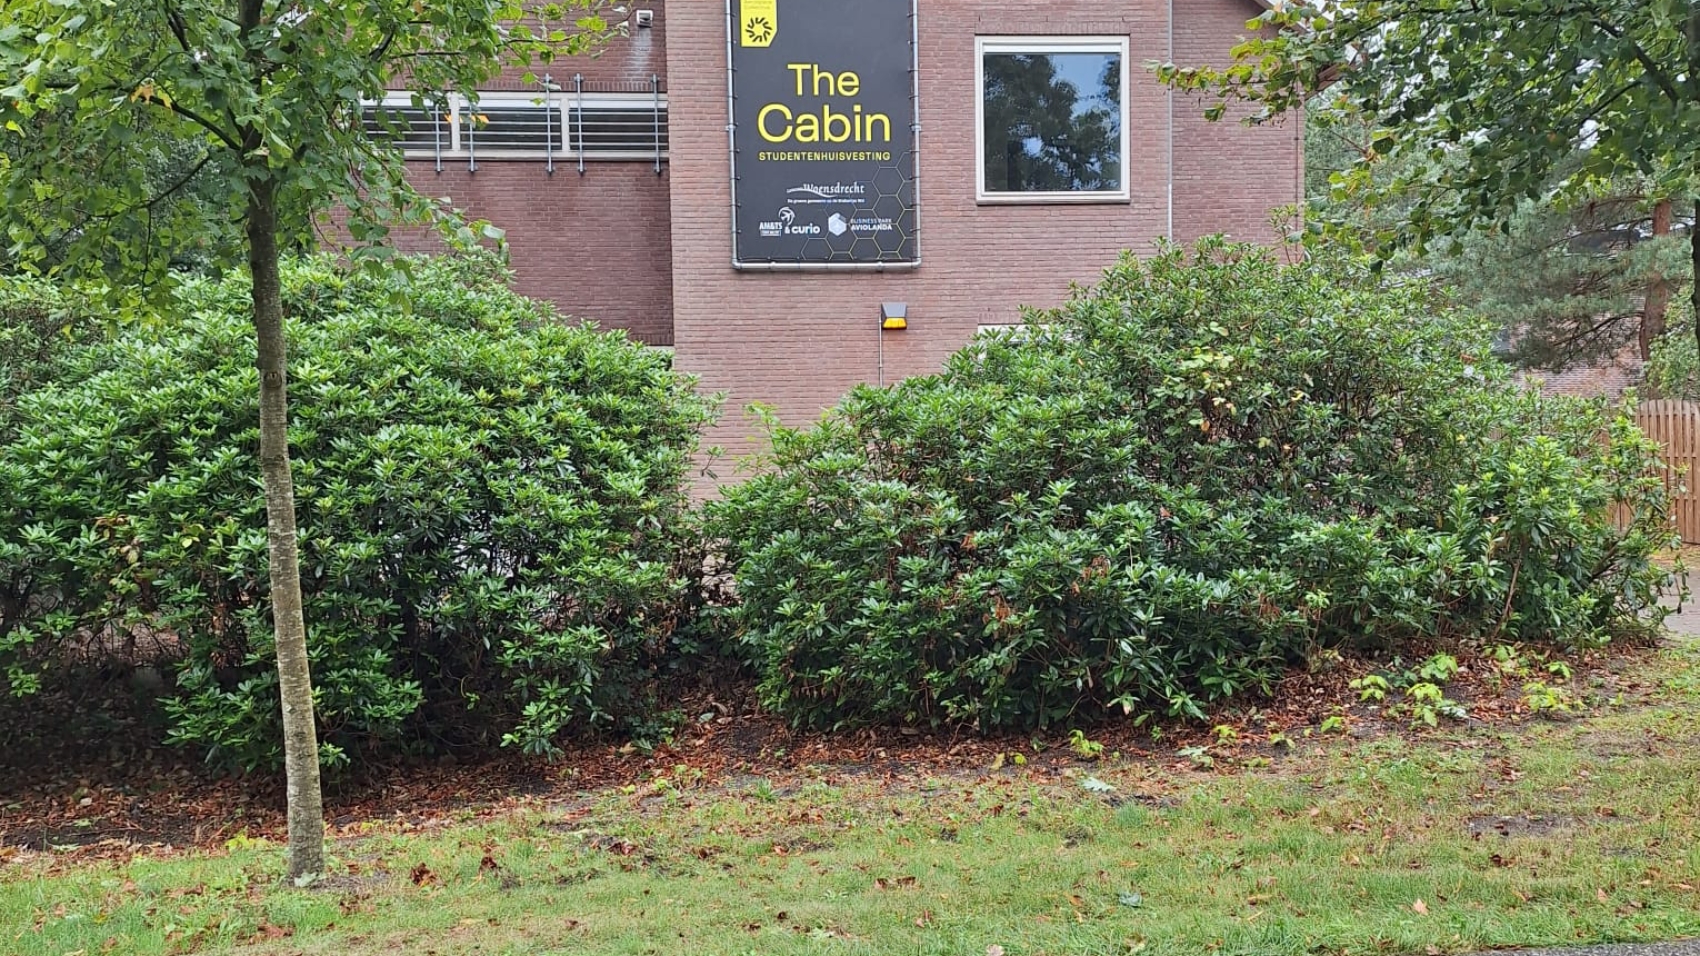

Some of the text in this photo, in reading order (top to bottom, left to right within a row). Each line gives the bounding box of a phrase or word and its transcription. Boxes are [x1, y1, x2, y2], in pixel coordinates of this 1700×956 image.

[787, 63, 860, 97] The
[757, 103, 891, 143] Cabin
[758, 151, 891, 162] STUDENTENHUISVESTING
[803, 181, 865, 195] Woensdrecht
[791, 222, 821, 234] curio
